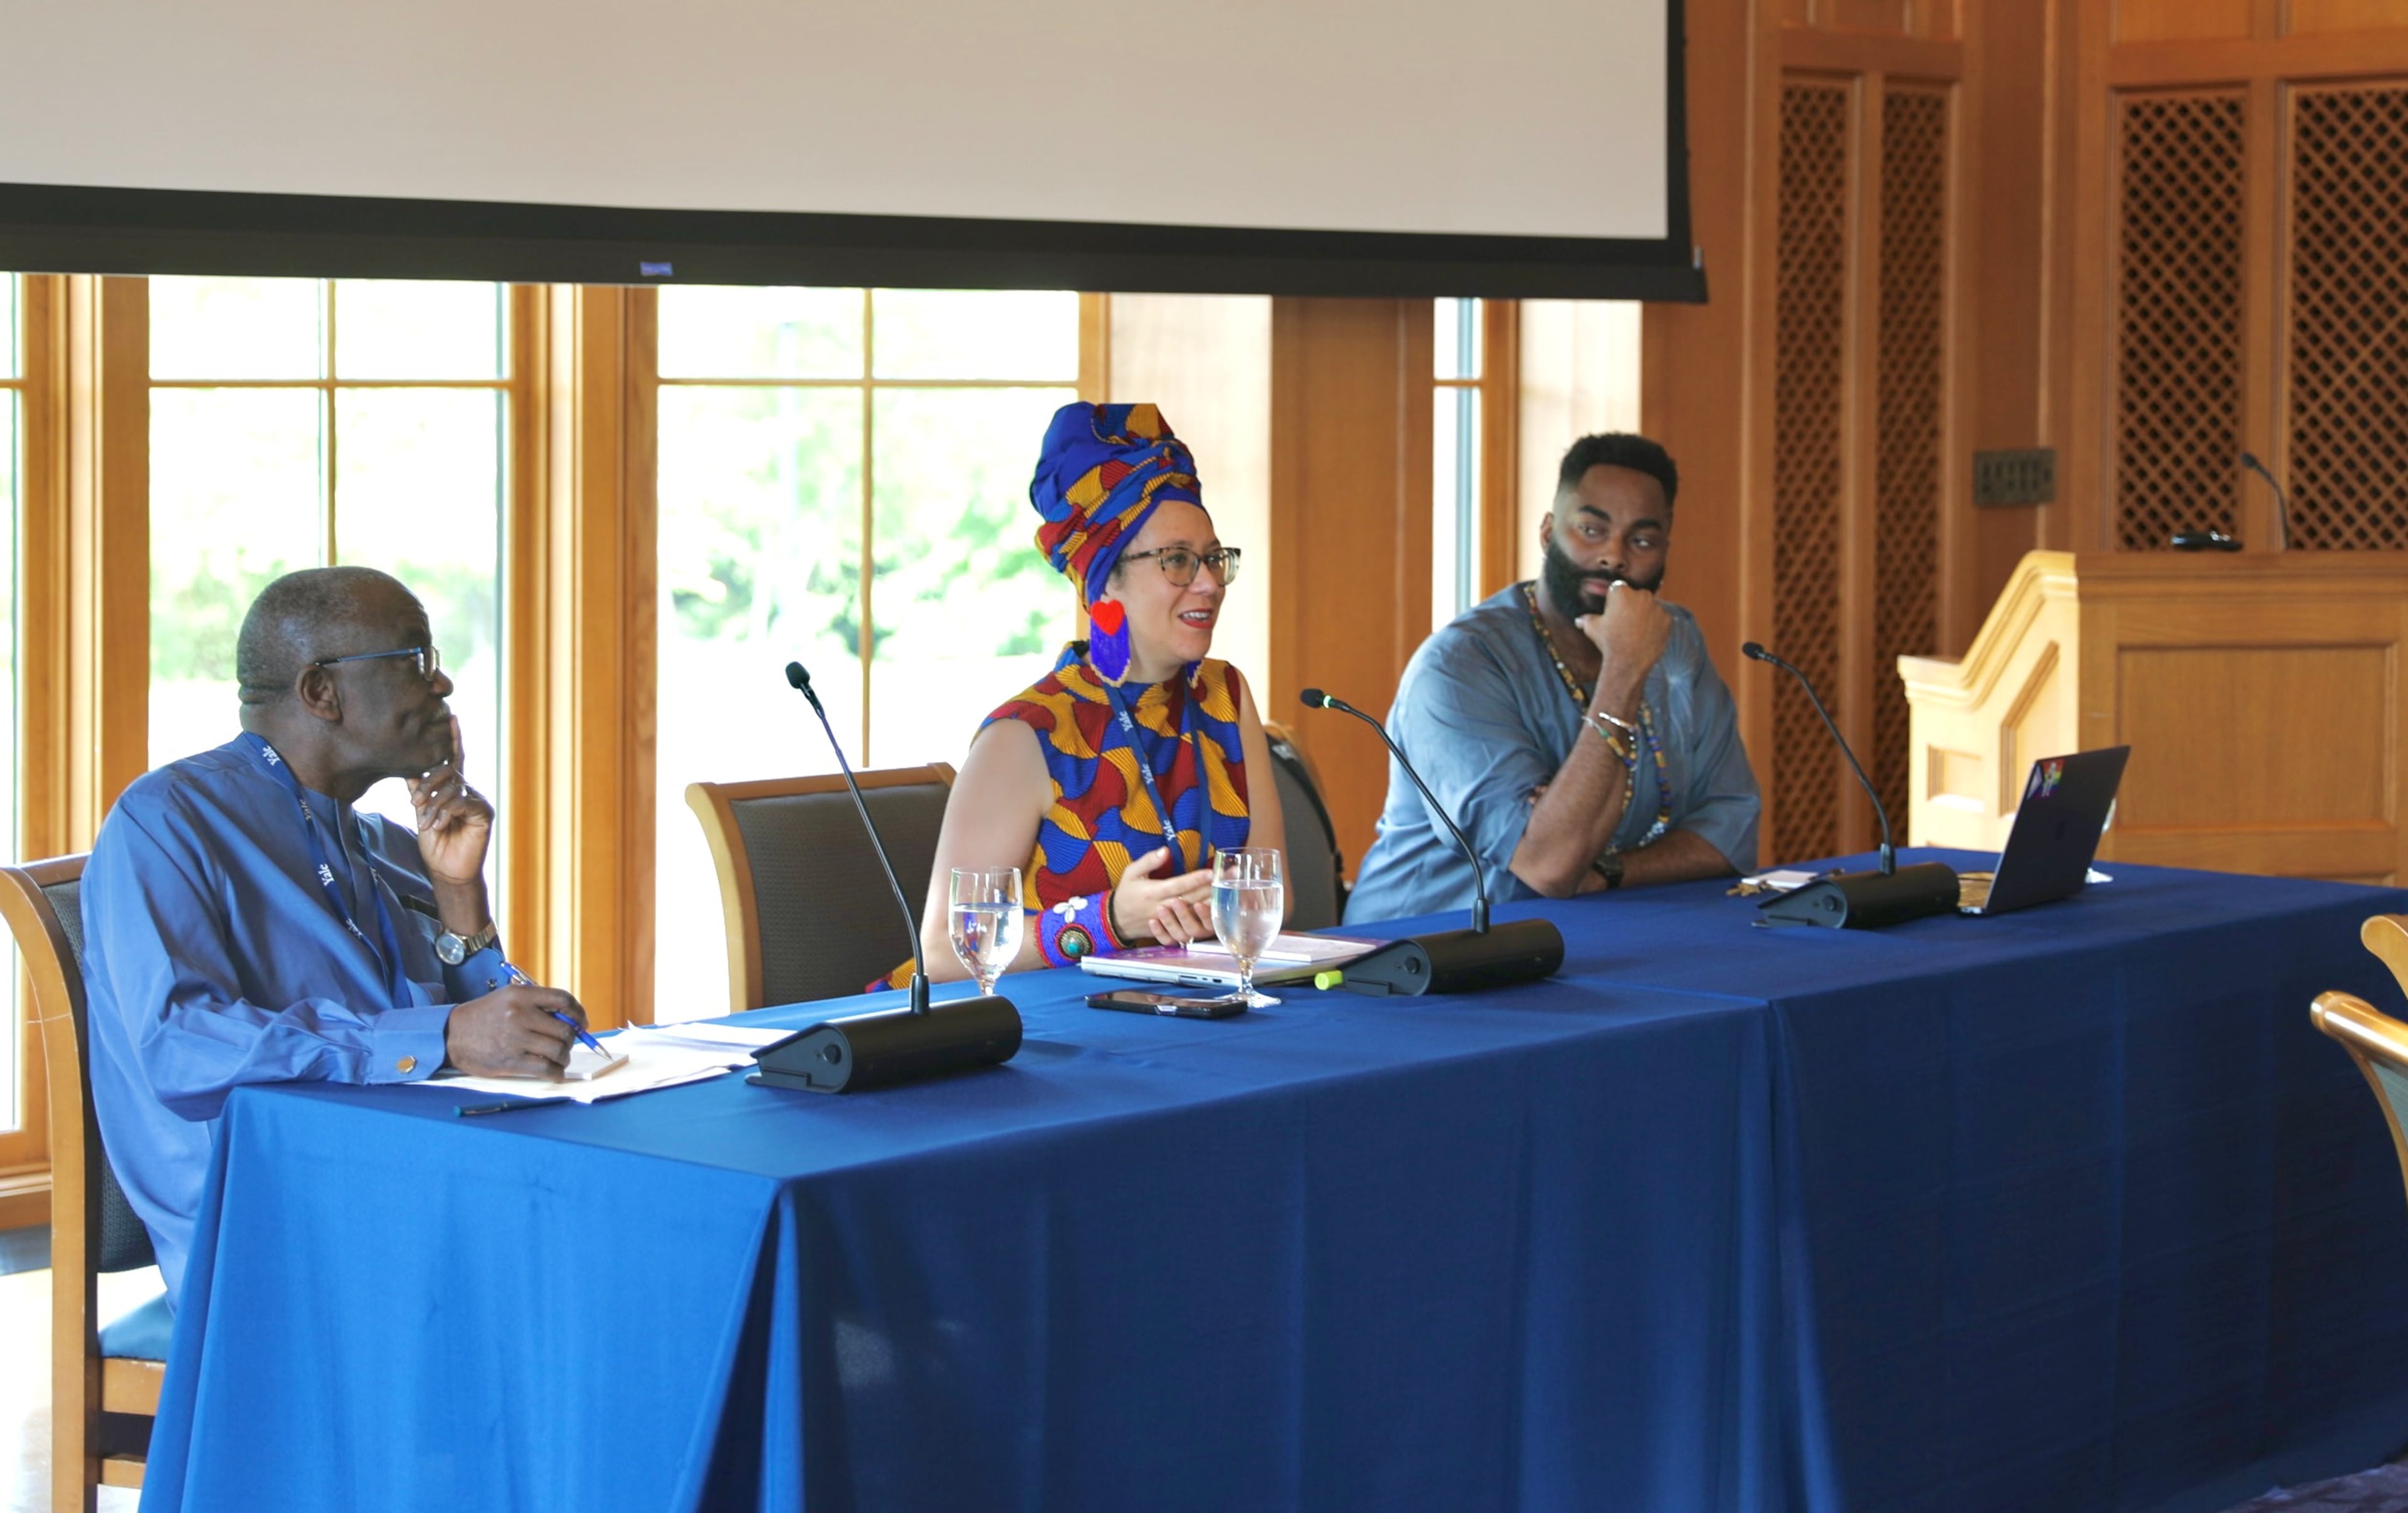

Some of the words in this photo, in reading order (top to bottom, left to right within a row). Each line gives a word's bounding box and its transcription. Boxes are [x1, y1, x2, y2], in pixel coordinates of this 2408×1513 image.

[1119, 711, 1134, 732] Yale
[263, 745, 281, 766] Yale
[1142, 763, 1154, 784] Yale
[1163, 820, 1176, 841] Yale
[318, 863, 334, 886] Yale
